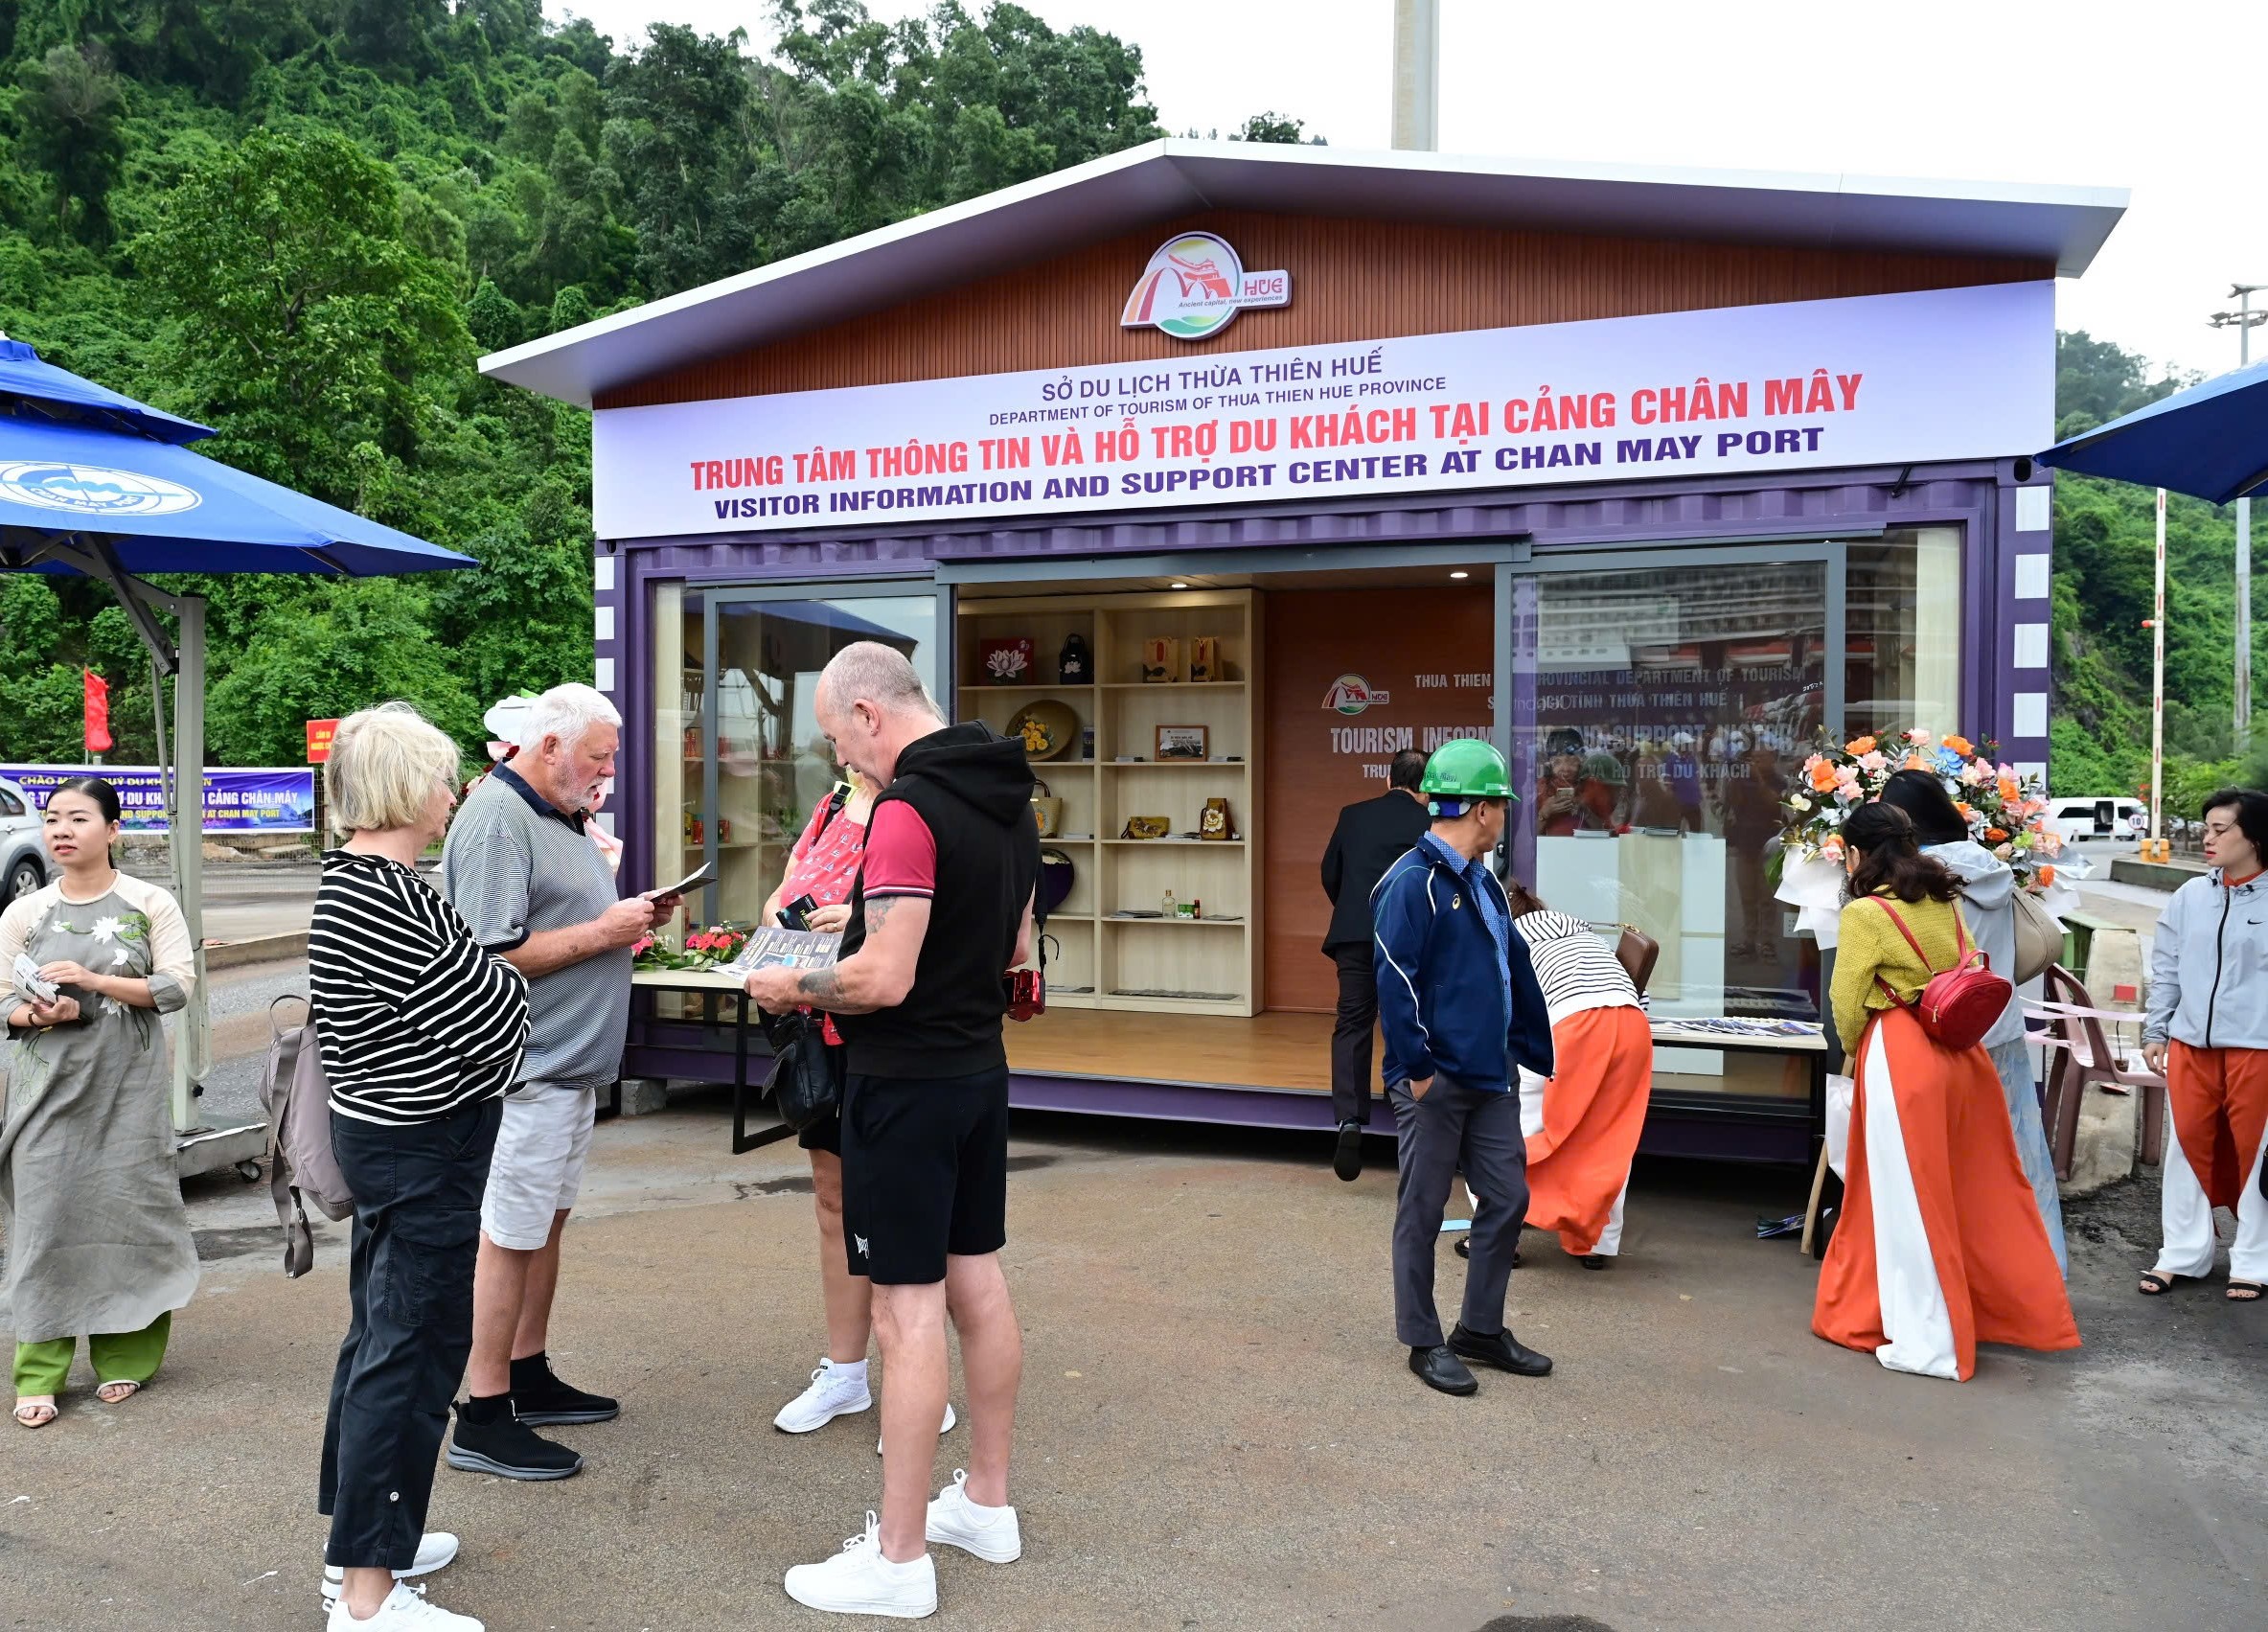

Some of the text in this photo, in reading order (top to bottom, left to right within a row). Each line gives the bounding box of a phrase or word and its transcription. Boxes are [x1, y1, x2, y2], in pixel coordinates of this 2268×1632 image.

[1204, 298, 1227, 307] capital,
[1244, 294, 1283, 303] experiences
[1042, 346, 1383, 402] SỞ DU LỊCH THỪA THIÊN HUẾ
[990, 377, 1446, 425] DEPARTMENT OF TOURISM OF THUA THIEN HUE PROVINCE
[691, 368, 1863, 491] TRUNG TÂM THÔNG TIN VÀ HỖ TRỢ DU KHÁCH TẠI CẢNG CHÂN MÂY
[714, 427, 1824, 519] VISITOR INFORMATION AND SUPPORT CENTER AT CHAN MAY PORT
[1414, 675, 1448, 688] THUA
[1454, 674, 1491, 688] THIEN
[1330, 726, 1413, 754] TOURISM
[19, 775, 56, 785] CHÀO
[126, 792, 144, 805] DU
[208, 789, 240, 805] CẢNG
[241, 791, 273, 805] CHÂN
[275, 791, 299, 805] MÂY
[261, 810, 281, 818] PORT
